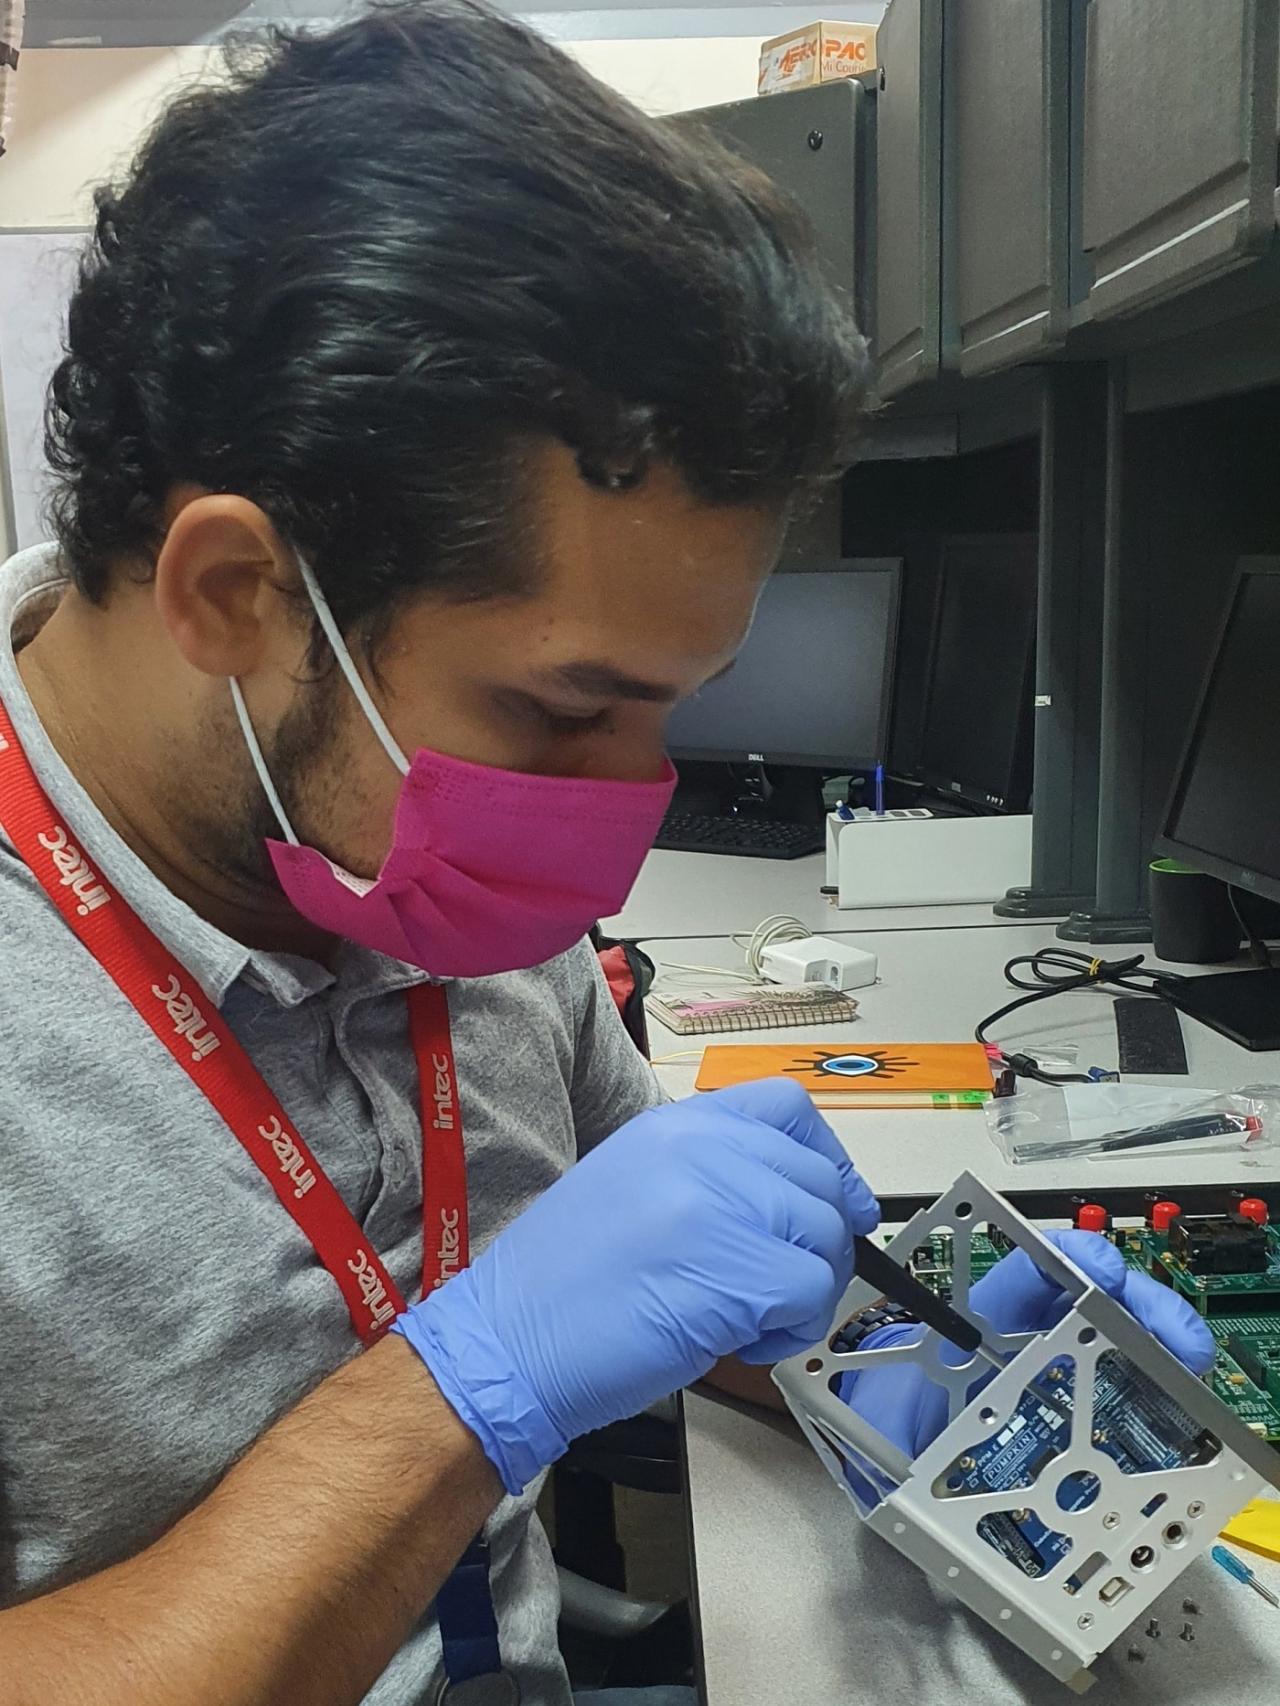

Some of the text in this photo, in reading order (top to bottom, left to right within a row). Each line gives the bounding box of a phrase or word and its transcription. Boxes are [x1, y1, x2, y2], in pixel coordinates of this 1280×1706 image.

[748, 753, 764, 761] DELL
[38, 825, 111, 916] intec
[152, 974, 221, 1062] intec
[432, 1053, 454, 1130] intec
[257, 1115, 317, 1198] intec
[347, 1249, 396, 1330] intec
[987, 1433, 1032, 1480] PUMPKIN
